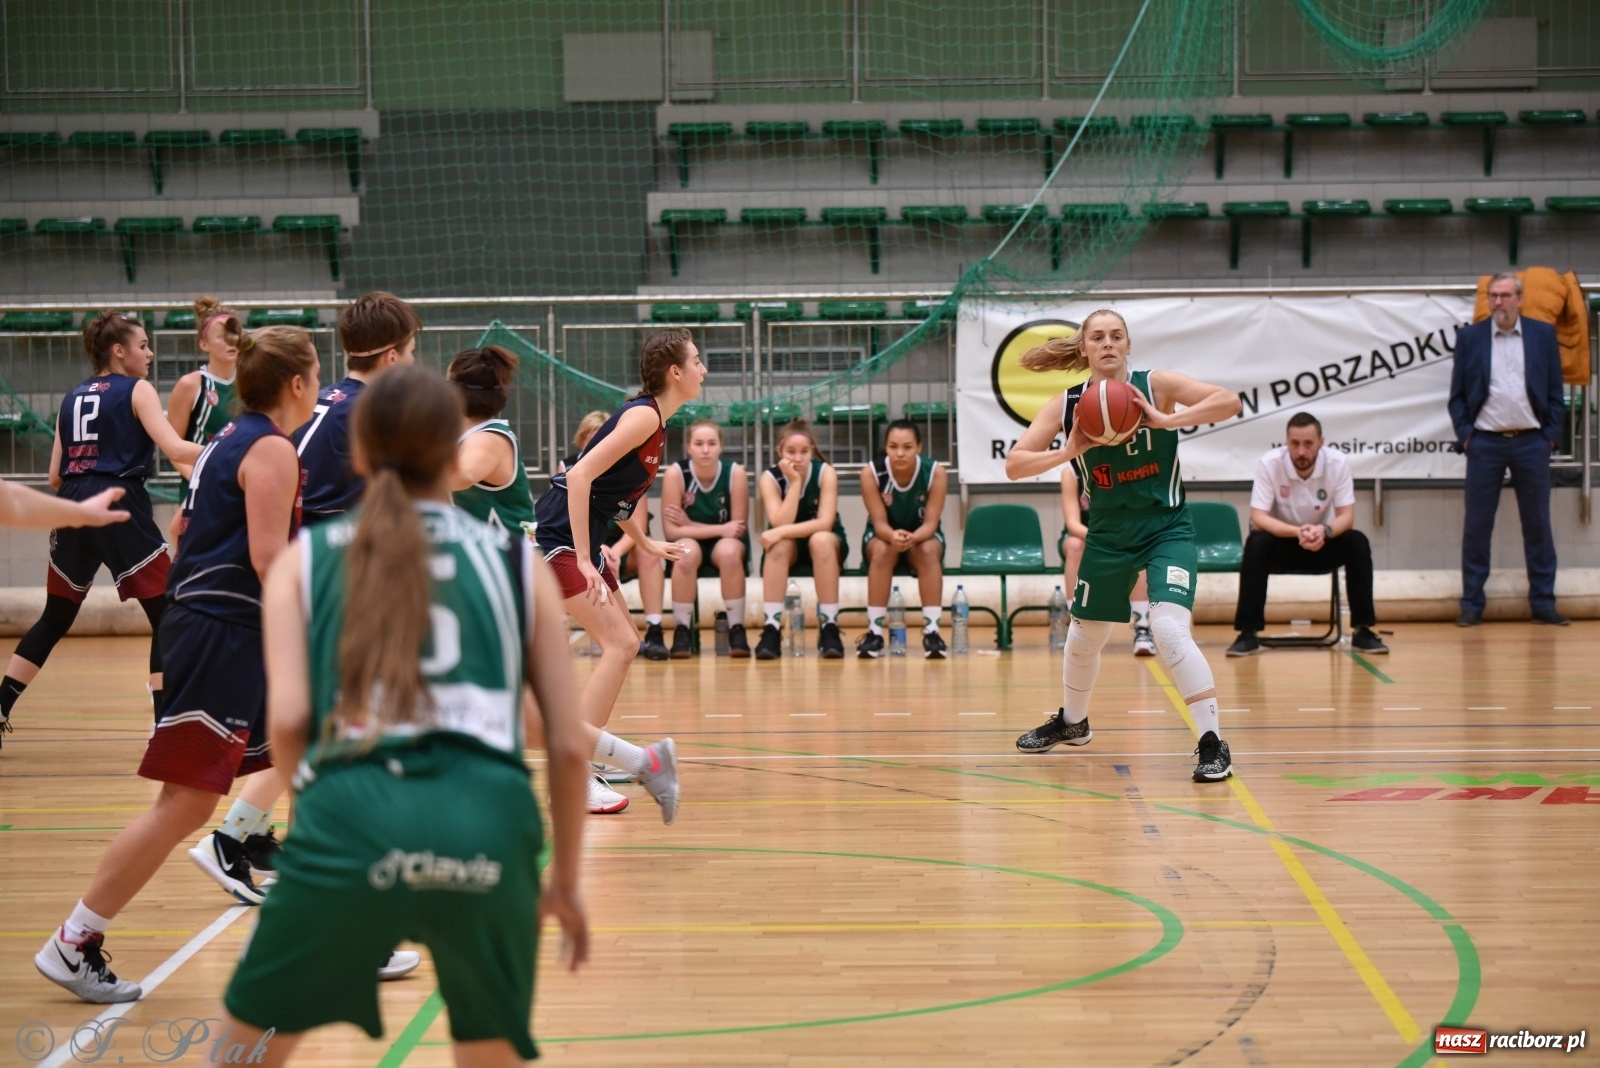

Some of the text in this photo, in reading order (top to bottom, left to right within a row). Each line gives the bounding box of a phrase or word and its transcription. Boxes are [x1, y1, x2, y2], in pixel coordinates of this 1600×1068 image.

[1269, 322, 1469, 407] PORZĄDKU
[73, 394, 101, 442] 12
[1126, 427, 1152, 456] 27
[1073, 576, 1090, 608] 7
